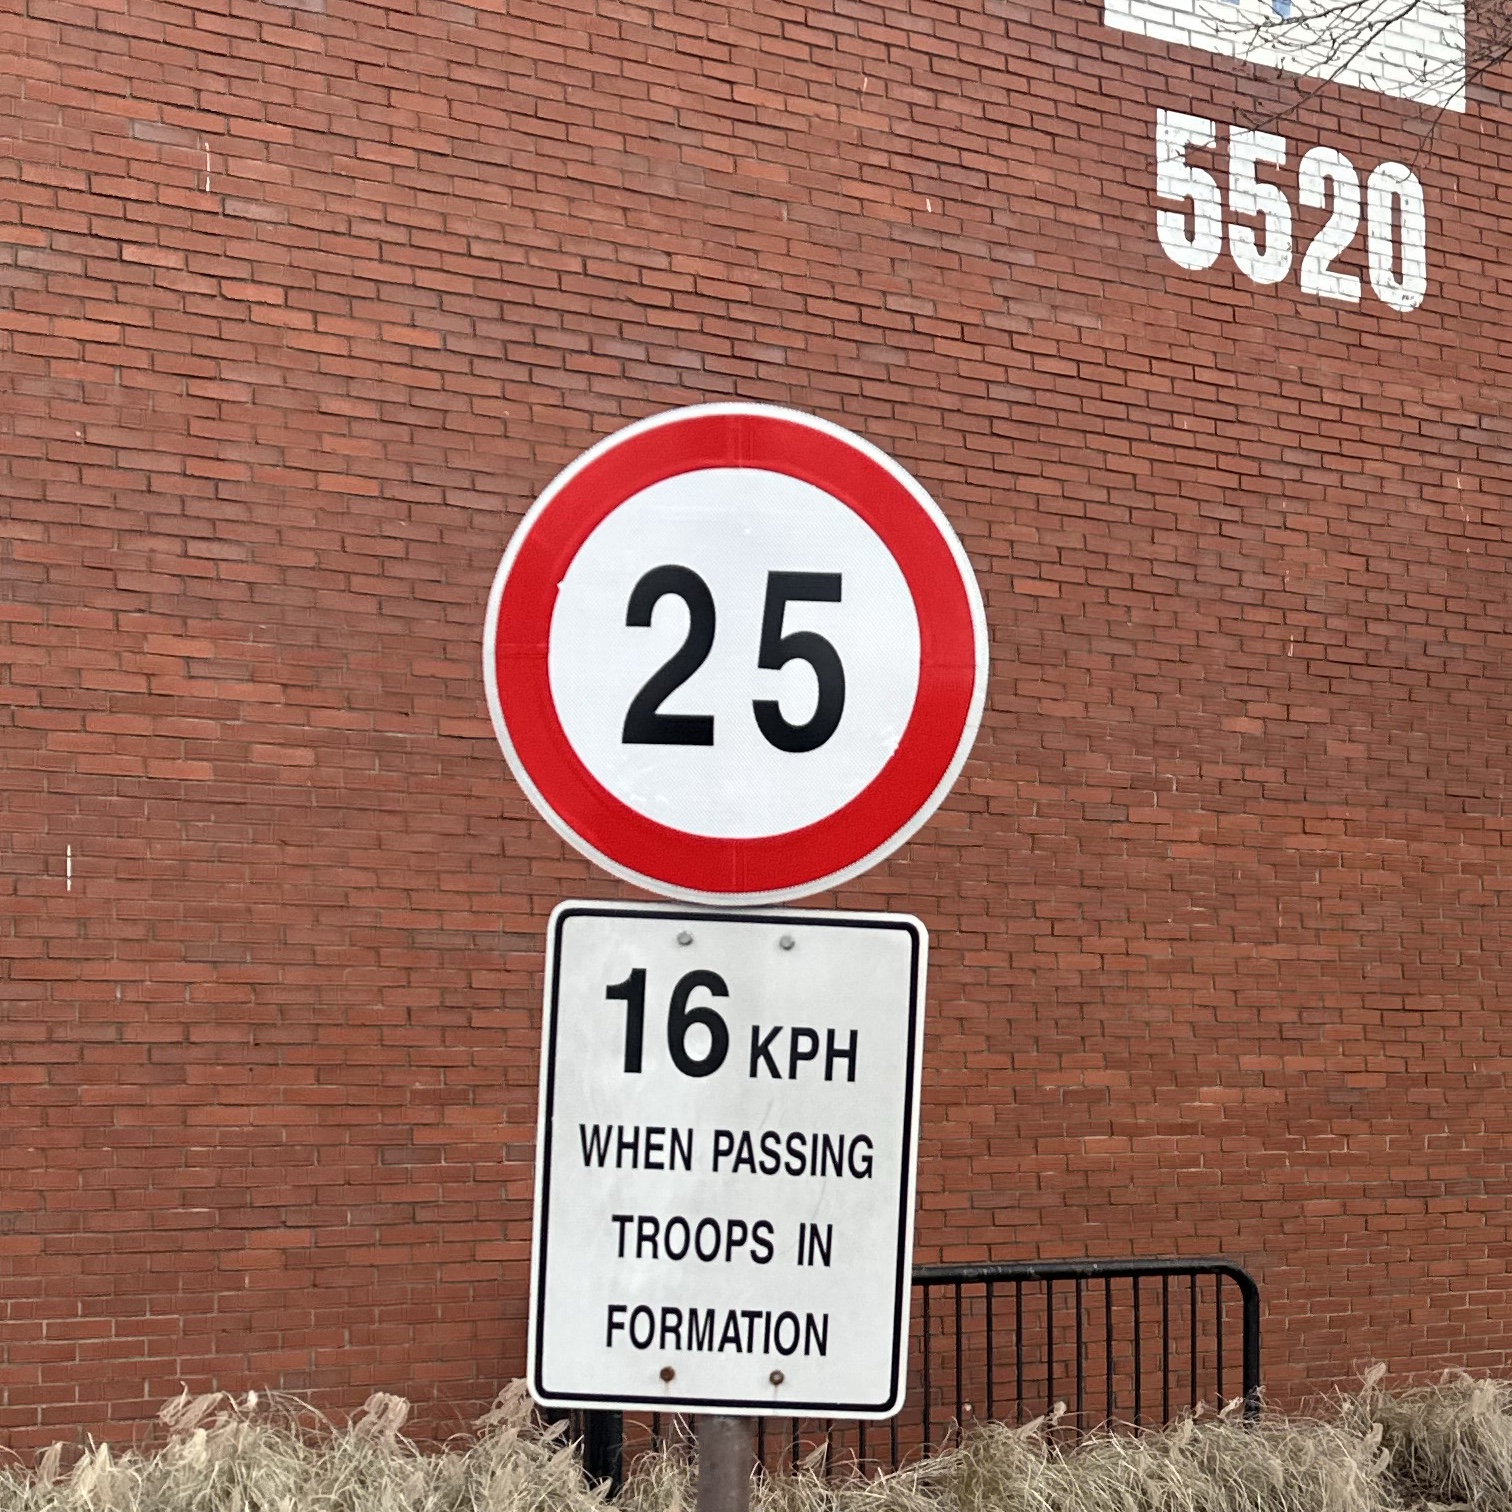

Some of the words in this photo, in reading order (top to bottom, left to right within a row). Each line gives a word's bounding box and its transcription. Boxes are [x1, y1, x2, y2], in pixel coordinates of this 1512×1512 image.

[1156, 108, 1427, 313] 5520
[621, 564, 846, 753] 25
[605, 967, 730, 1078] 16
[749, 1024, 858, 1083] KPH
[579, 1124, 693, 1171] WHEN
[712, 1129, 874, 1180] PASSING
[612, 1214, 774, 1265] TROOPS
[797, 1223, 833, 1267] IN
[605, 1305, 829, 1357] FORMATION
